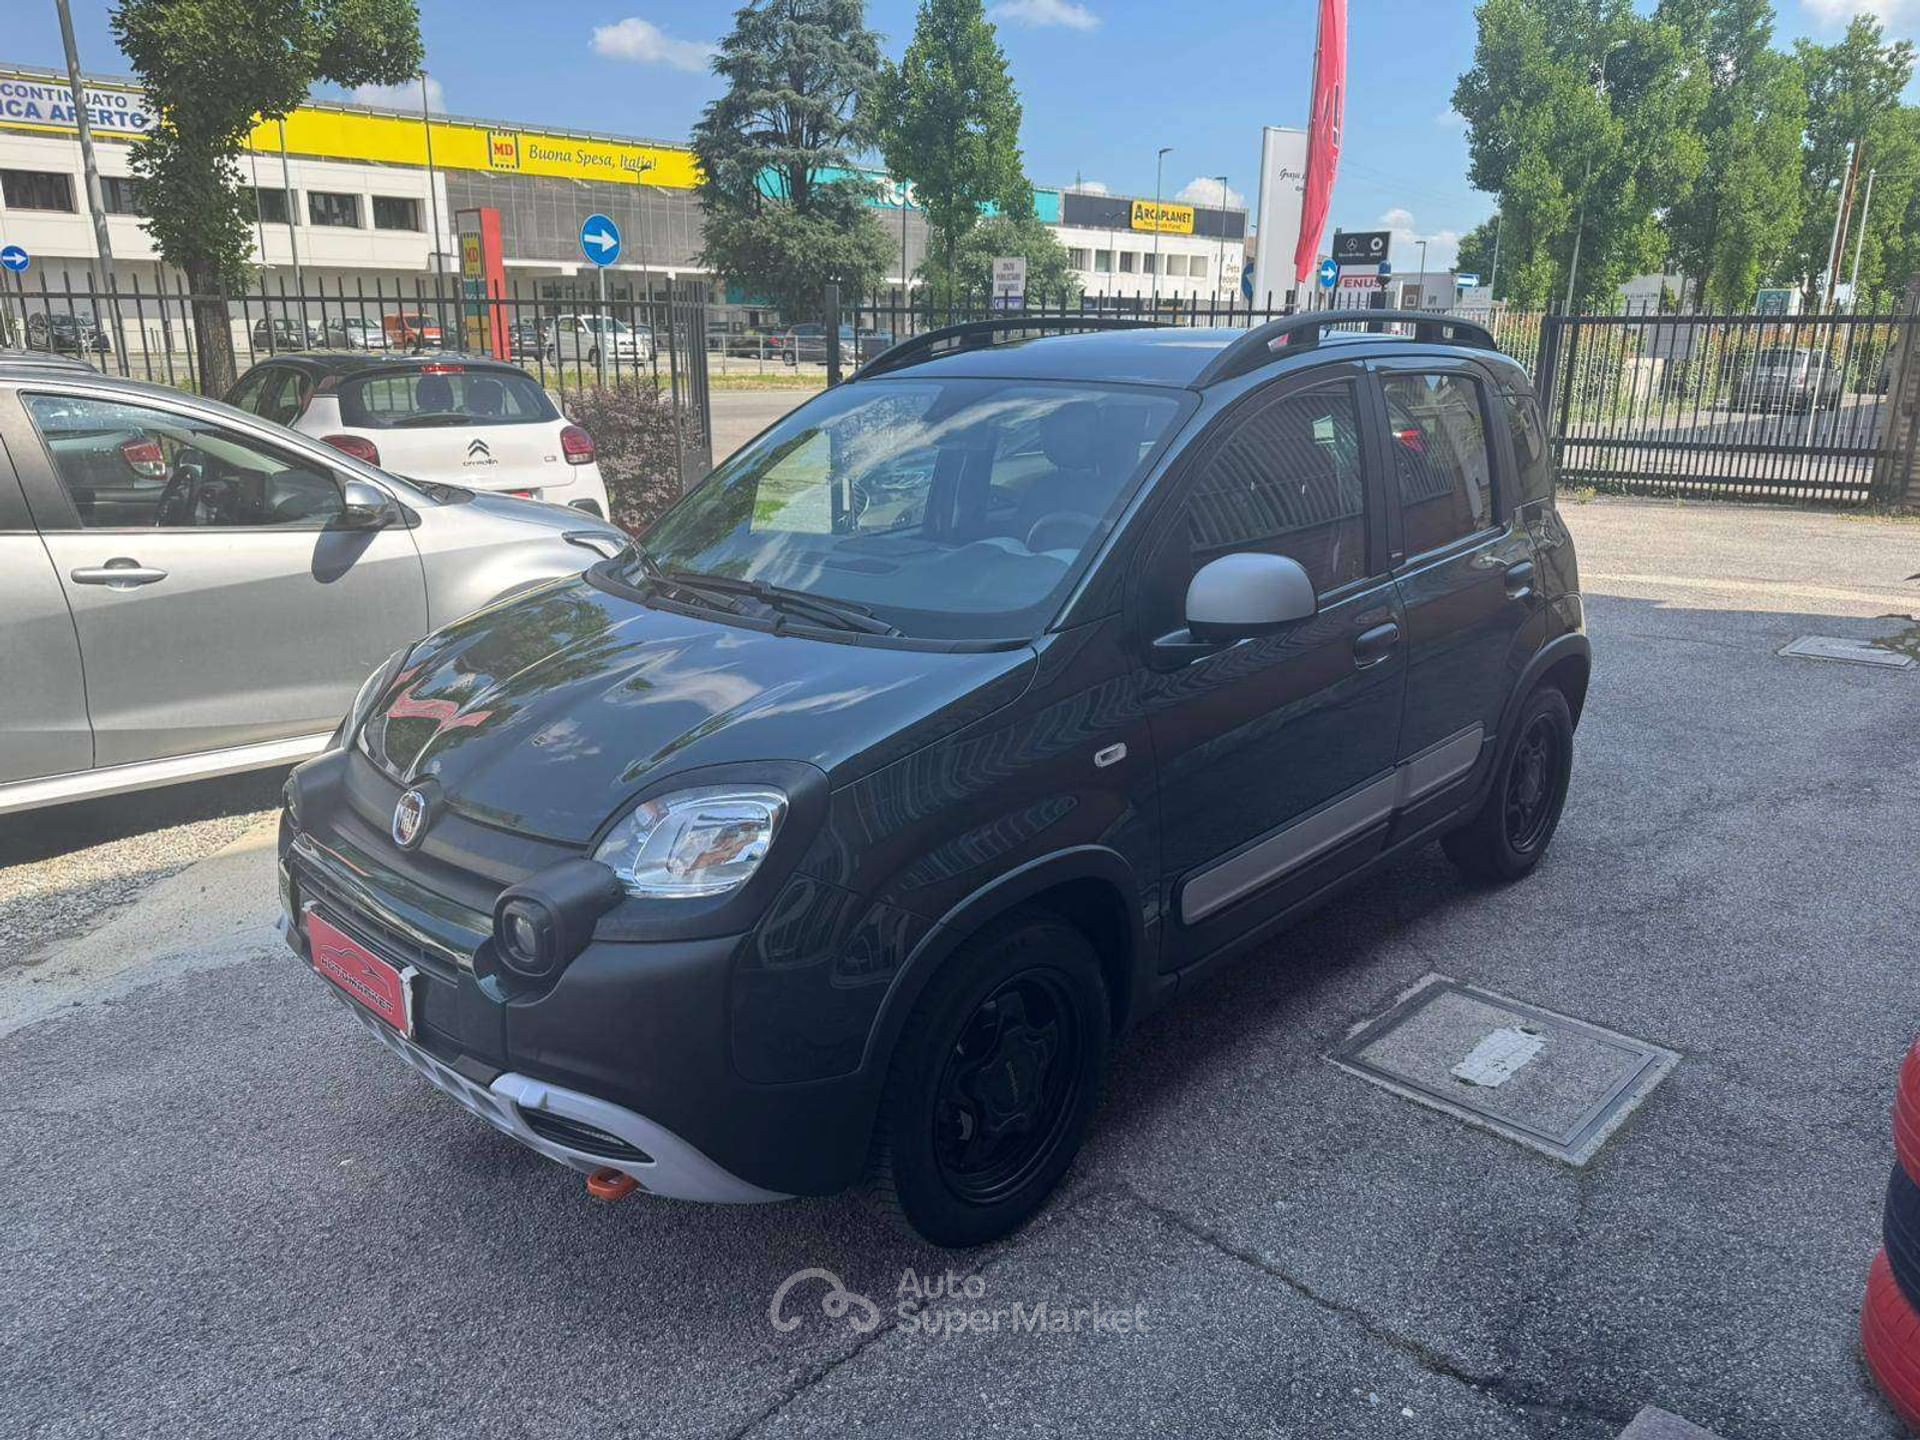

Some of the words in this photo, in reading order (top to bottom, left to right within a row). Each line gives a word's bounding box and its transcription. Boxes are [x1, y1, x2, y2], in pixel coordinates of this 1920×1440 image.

[493, 142, 514, 157] MD
[529, 144, 572, 162] Buona
[575, 149, 616, 169] Spesa,
[620, 154, 657, 171] Italia!
